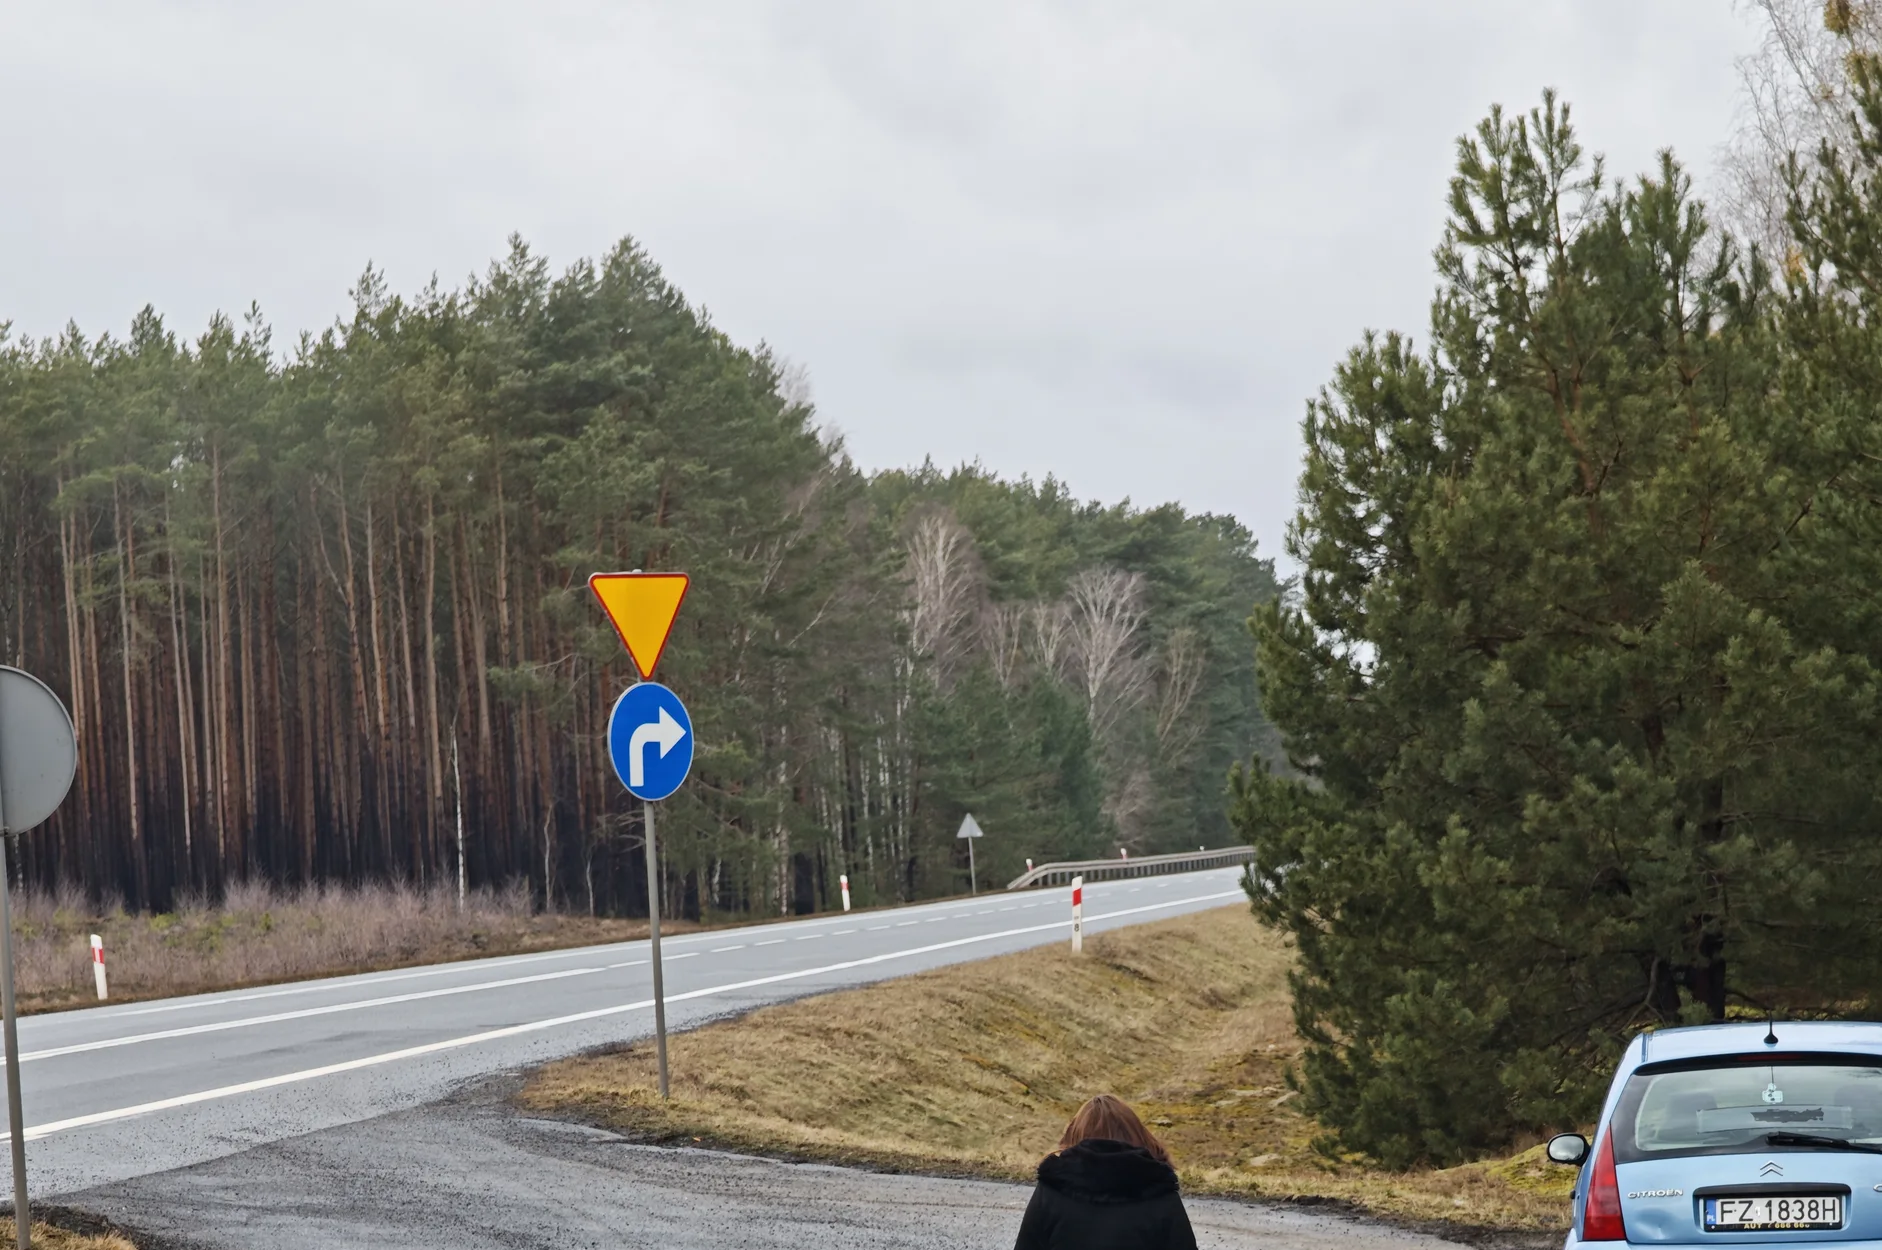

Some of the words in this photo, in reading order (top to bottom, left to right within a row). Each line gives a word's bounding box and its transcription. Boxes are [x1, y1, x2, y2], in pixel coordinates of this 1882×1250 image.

[1627, 1188, 1683, 1199] CITROËN
[1720, 1200, 1754, 1222] FZ
[1765, 1199, 1836, 1222] 1838H
